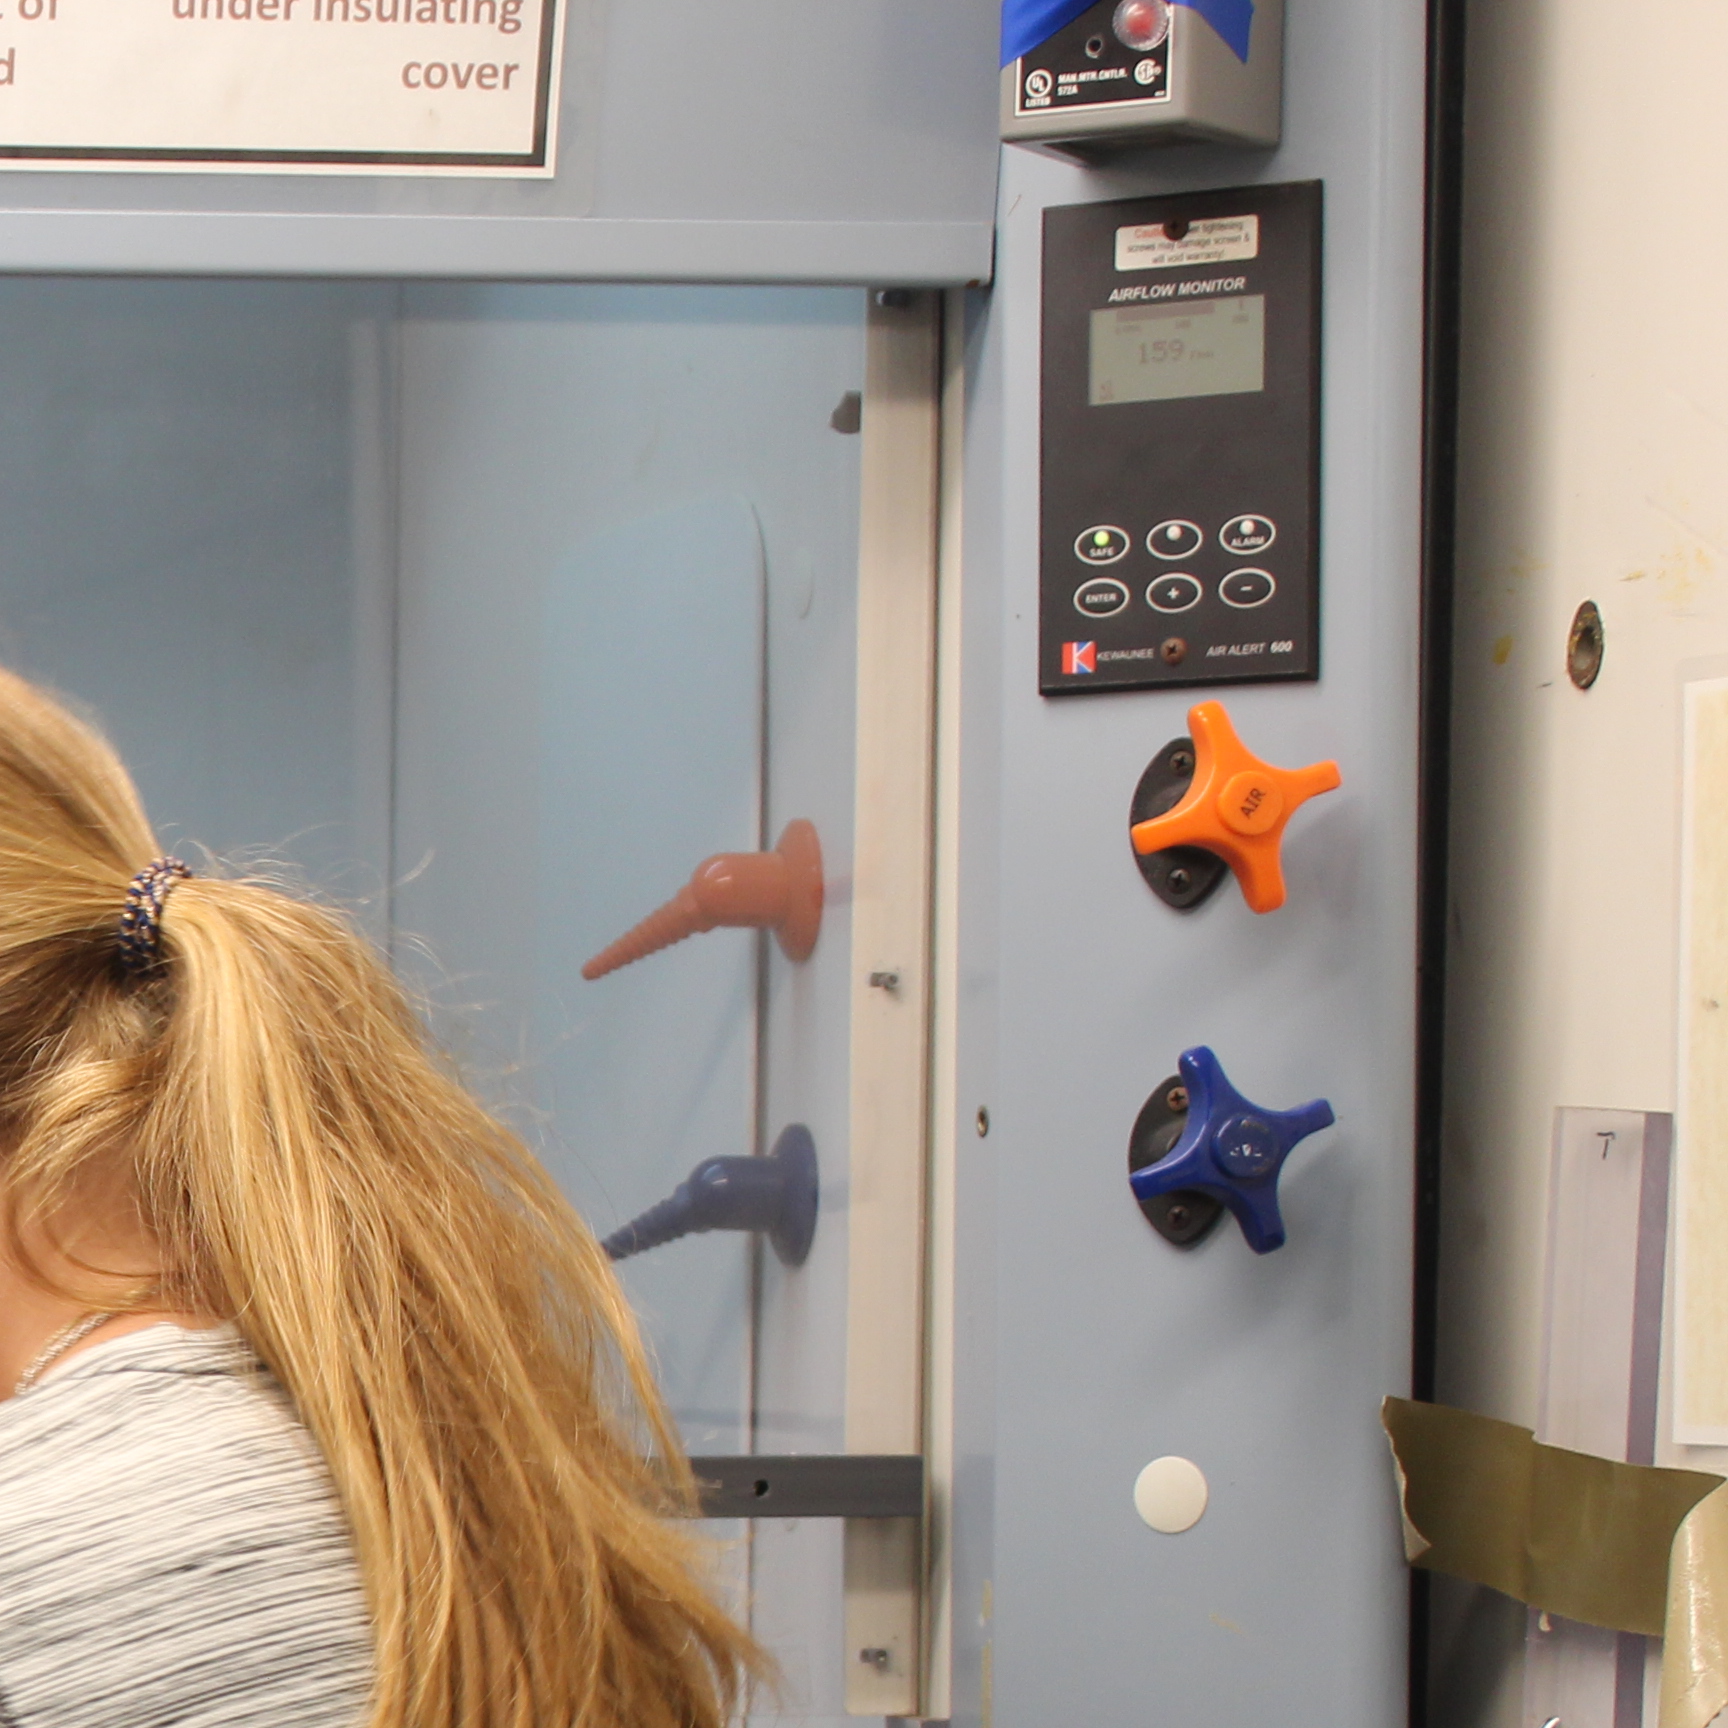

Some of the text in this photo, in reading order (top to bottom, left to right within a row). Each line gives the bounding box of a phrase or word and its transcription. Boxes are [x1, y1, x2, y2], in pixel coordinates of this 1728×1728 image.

[401, 61, 519, 90] cover
[1107, 276, 1246, 303] AIRFLOW MONITOR
[1138, 338, 1185, 365] 159
[1089, 546, 1115, 558] SAFE
[1230, 536, 1265, 547] ALARM
[1085, 593, 1117, 604] ENTER
[1097, 648, 1155, 661] KEWAUNEE
[1205, 640, 1294, 658] AIR ALERT 600
[1240, 788, 1267, 820] AIR
[1595, 1130, 1617, 1161] 7
